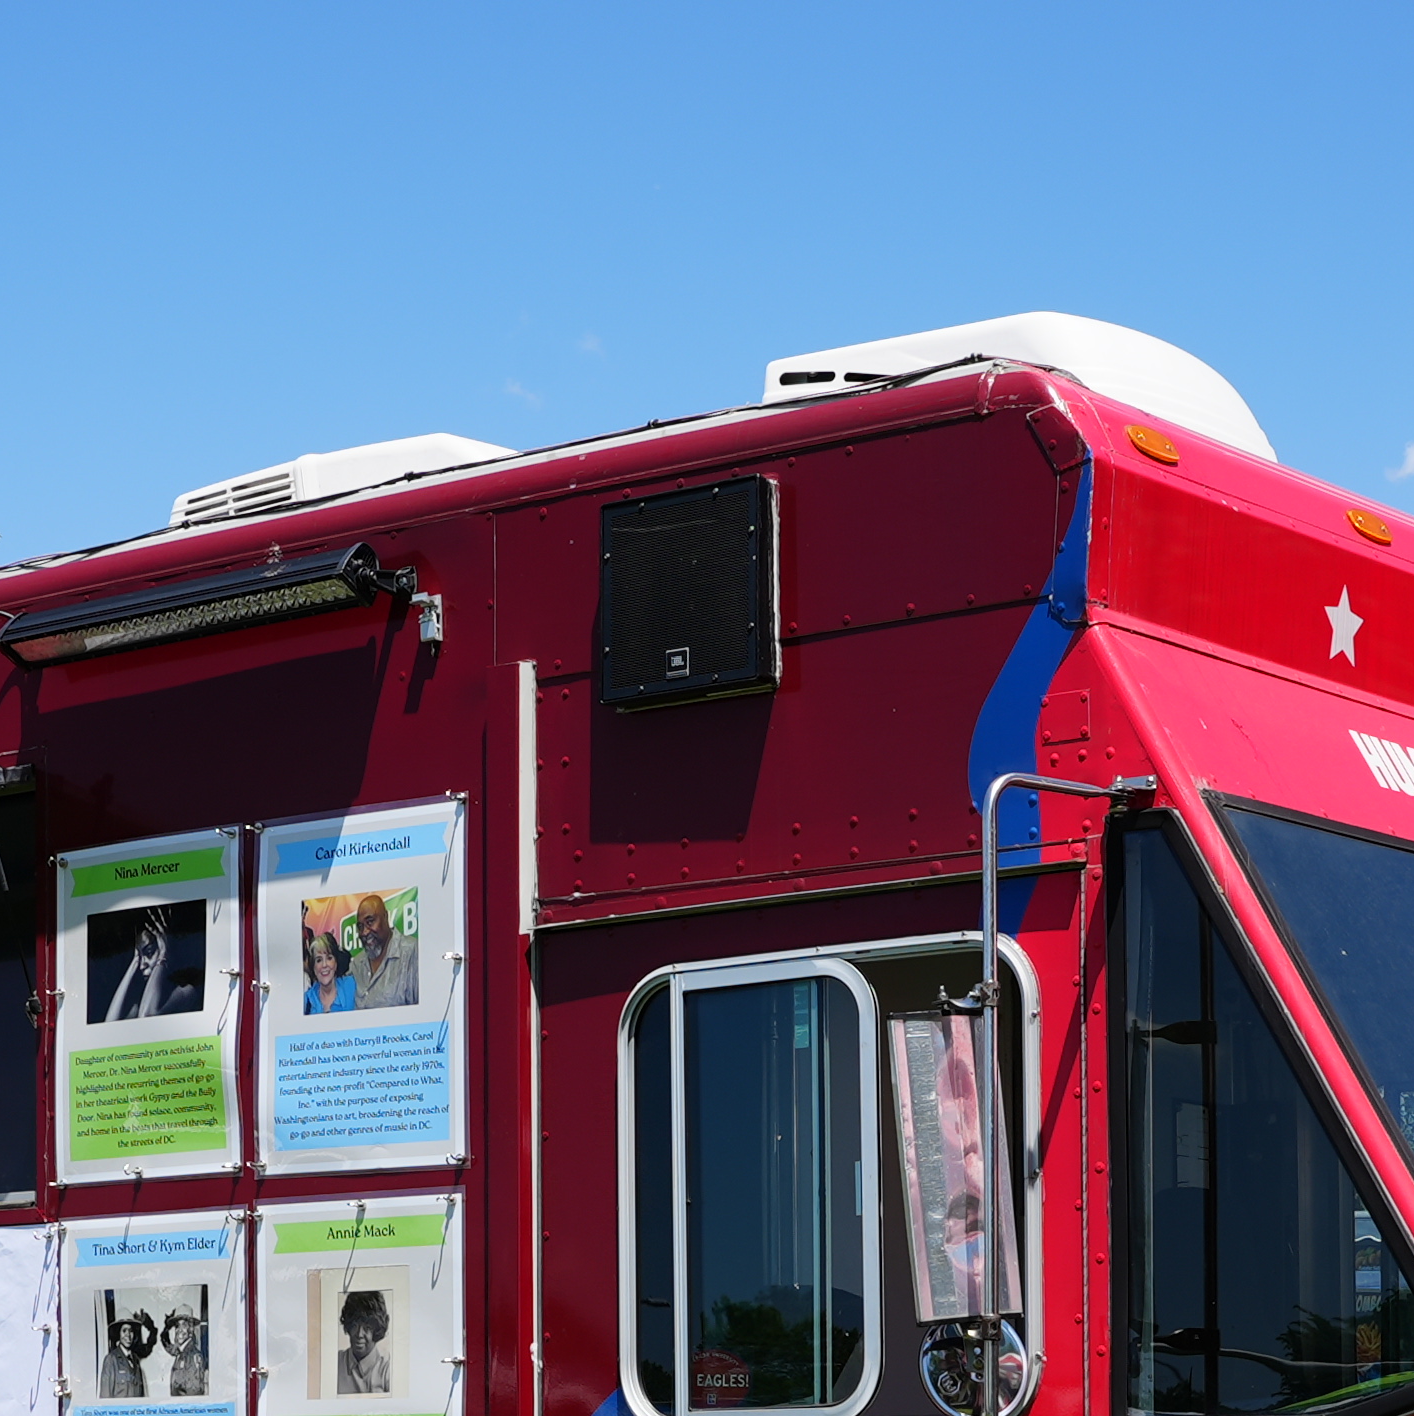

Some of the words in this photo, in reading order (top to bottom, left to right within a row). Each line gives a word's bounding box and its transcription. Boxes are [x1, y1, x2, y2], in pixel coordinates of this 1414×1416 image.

[315, 844, 346, 861] Carol
[349, 836, 411, 858] Kirkendall
[114, 864, 138, 881] Nina
[141, 861, 180, 879] Mercer
[289, 1042, 305, 1052] Half
[305, 1041, 313, 1050] of
[321, 1041, 335, 1049] duo
[336, 1038, 352, 1047] with
[381, 1033, 411, 1044] Brooks,
[412, 1030, 433, 1041] Carol
[75, 1055, 106, 1066] Daughter
[106, 1053, 114, 1062] of
[114, 1050, 153, 1061] community
[154, 1049, 168, 1057] arts
[169, 1045, 194, 1055] activist
[195, 1043, 213, 1052] John
[278, 1056, 316, 1067] Kirkendall
[317, 1055, 331, 1063] has
[332, 1054, 350, 1062] been
[357, 1049, 391, 1062] powerful
[392, 1049, 422, 1057] woman
[423, 1046, 431, 1055] in
[109, 1067, 120, 1076] Dr.
[120, 1066, 136, 1075] Nina
[137, 1064, 162, 1073] Mercer
[163, 1058, 206, 1070] successfully
[278, 1070, 331, 1081] entertainment
[332, 1068, 364, 1077] industry
[365, 1066, 385, 1074] since
[386, 1064, 399, 1072] the
[400, 1062, 419, 1072] early
[75, 1082, 113, 1095] highlighted
[114, 1081, 125, 1090] the
[126, 1078, 160, 1089] recurring
[160, 1076, 186, 1085] themes
[186, 1073, 194, 1082] of
[279, 1086, 312, 1096] founding
[313, 1084, 325, 1093] the
[75, 1100, 82, 1108] in
[83, 1099, 94, 1107] her
[95, 1095, 128, 1106] theatrical
[148, 1092, 170, 1103] Gypsy
[170, 1089, 184, 1099] and
[185, 1088, 196, 1097] the
[198, 1087, 216, 1097] Bully
[315, 1098, 333, 1107] with
[333, 1097, 346, 1106] the
[347, 1096, 378, 1107] purpose
[379, 1093, 388, 1103] of
[388, 1092, 424, 1103] exposing
[96, 1112, 112, 1121] Nina
[113, 1111, 126, 1119] has
[273, 1113, 333, 1125] Washingtonians
[358, 1109, 402, 1119] broadening
[403, 1107, 416, 1116] the
[418, 1105, 440, 1115] reach
[441, 1104, 449, 1113] of
[311, 1127, 325, 1137] and
[326, 1127, 346, 1135] other
[347, 1126, 373, 1136] genres
[374, 1123, 383, 1132] of
[384, 1122, 407, 1132] music
[409, 1122, 417, 1130] in
[117, 1139, 129, 1147] the
[130, 1138, 153, 1147] streets
[154, 1135, 162, 1144] of
[326, 1225, 361, 1241] Annie
[364, 1223, 396, 1239] Mack
[92, 1243, 115, 1256] Tina
[117, 1241, 146, 1255] Short
[148, 1240, 158, 1253] &
[160, 1239, 186, 1255] Kym
[187, 1237, 216, 1250] Elder
[696, 1373, 749, 1388] EAGLES!
